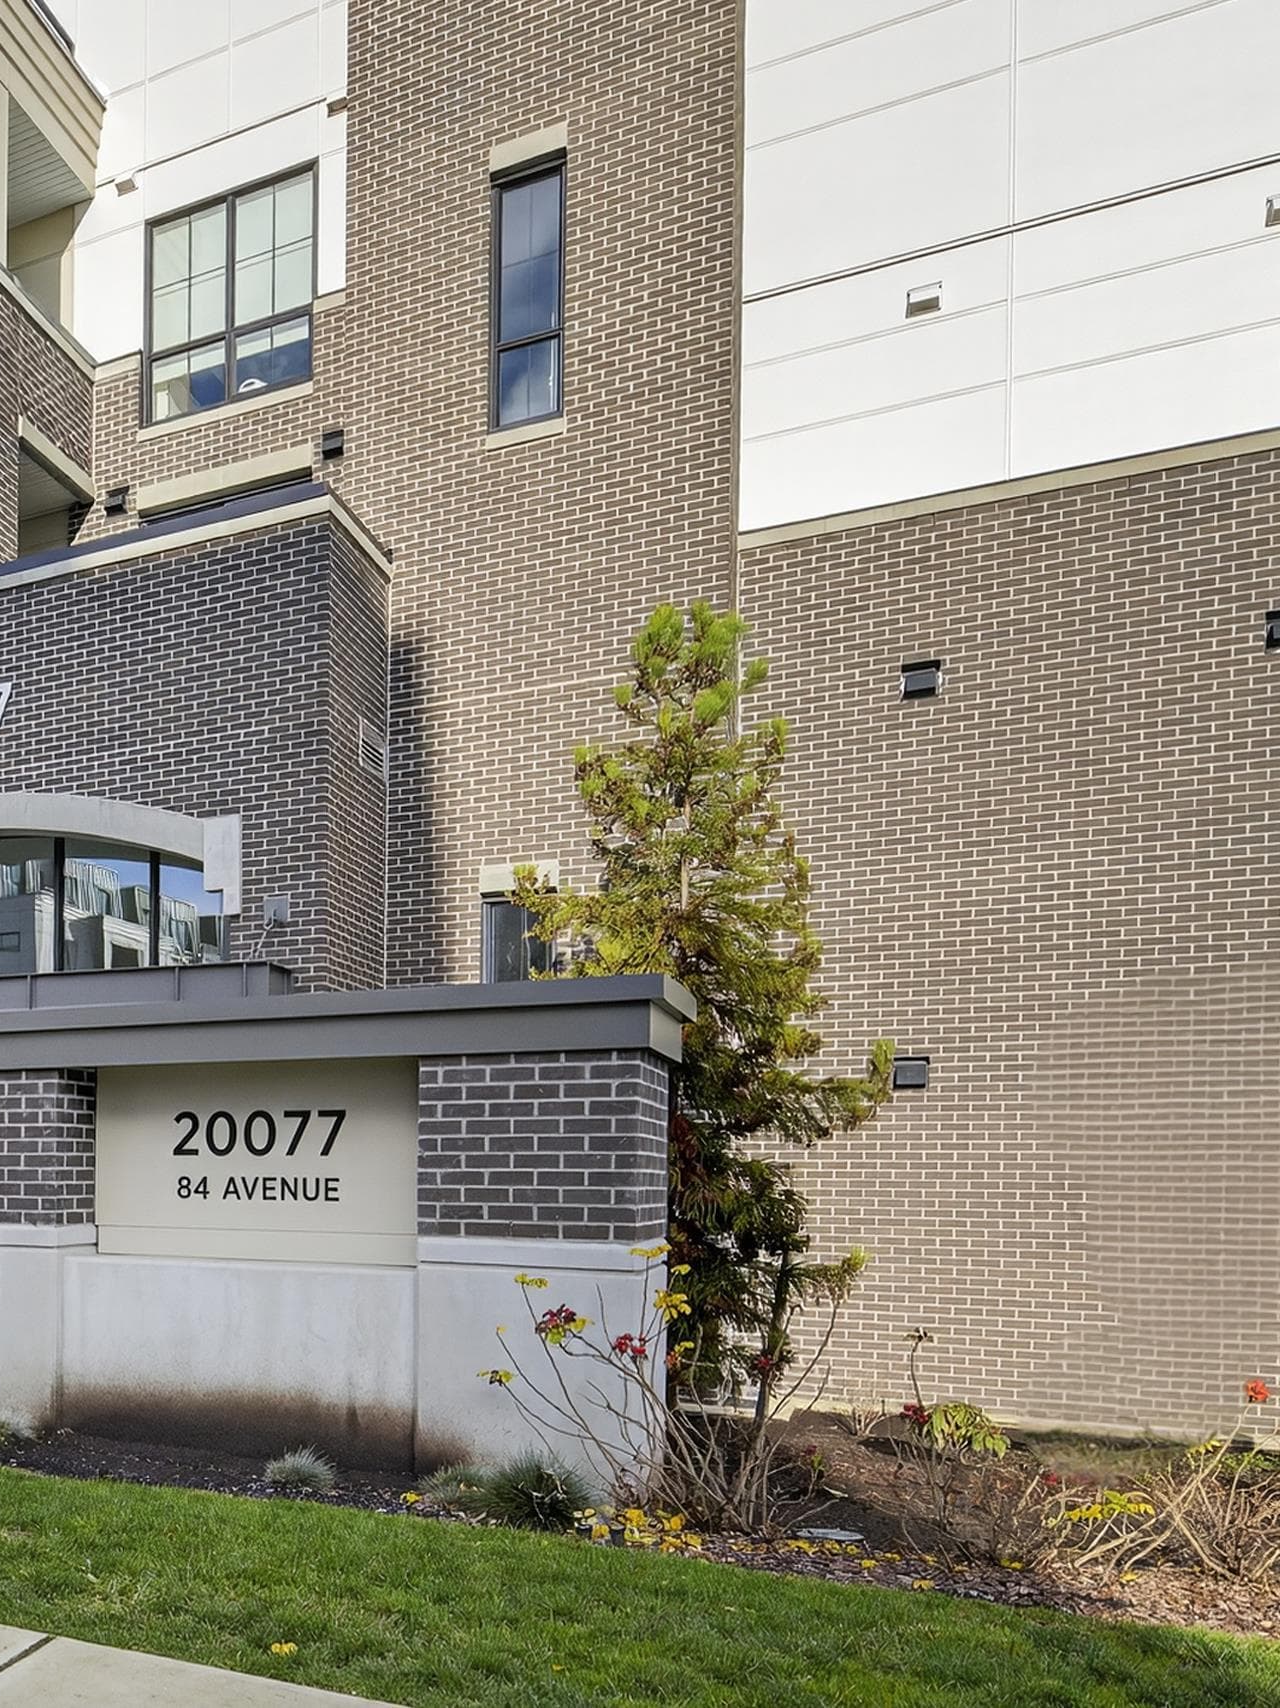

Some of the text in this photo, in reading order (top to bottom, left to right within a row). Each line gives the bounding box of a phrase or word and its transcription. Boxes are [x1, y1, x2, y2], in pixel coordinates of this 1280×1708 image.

[172, 1109, 347, 1157] 20077
[177, 1175, 340, 1201] 84 AVENUE
